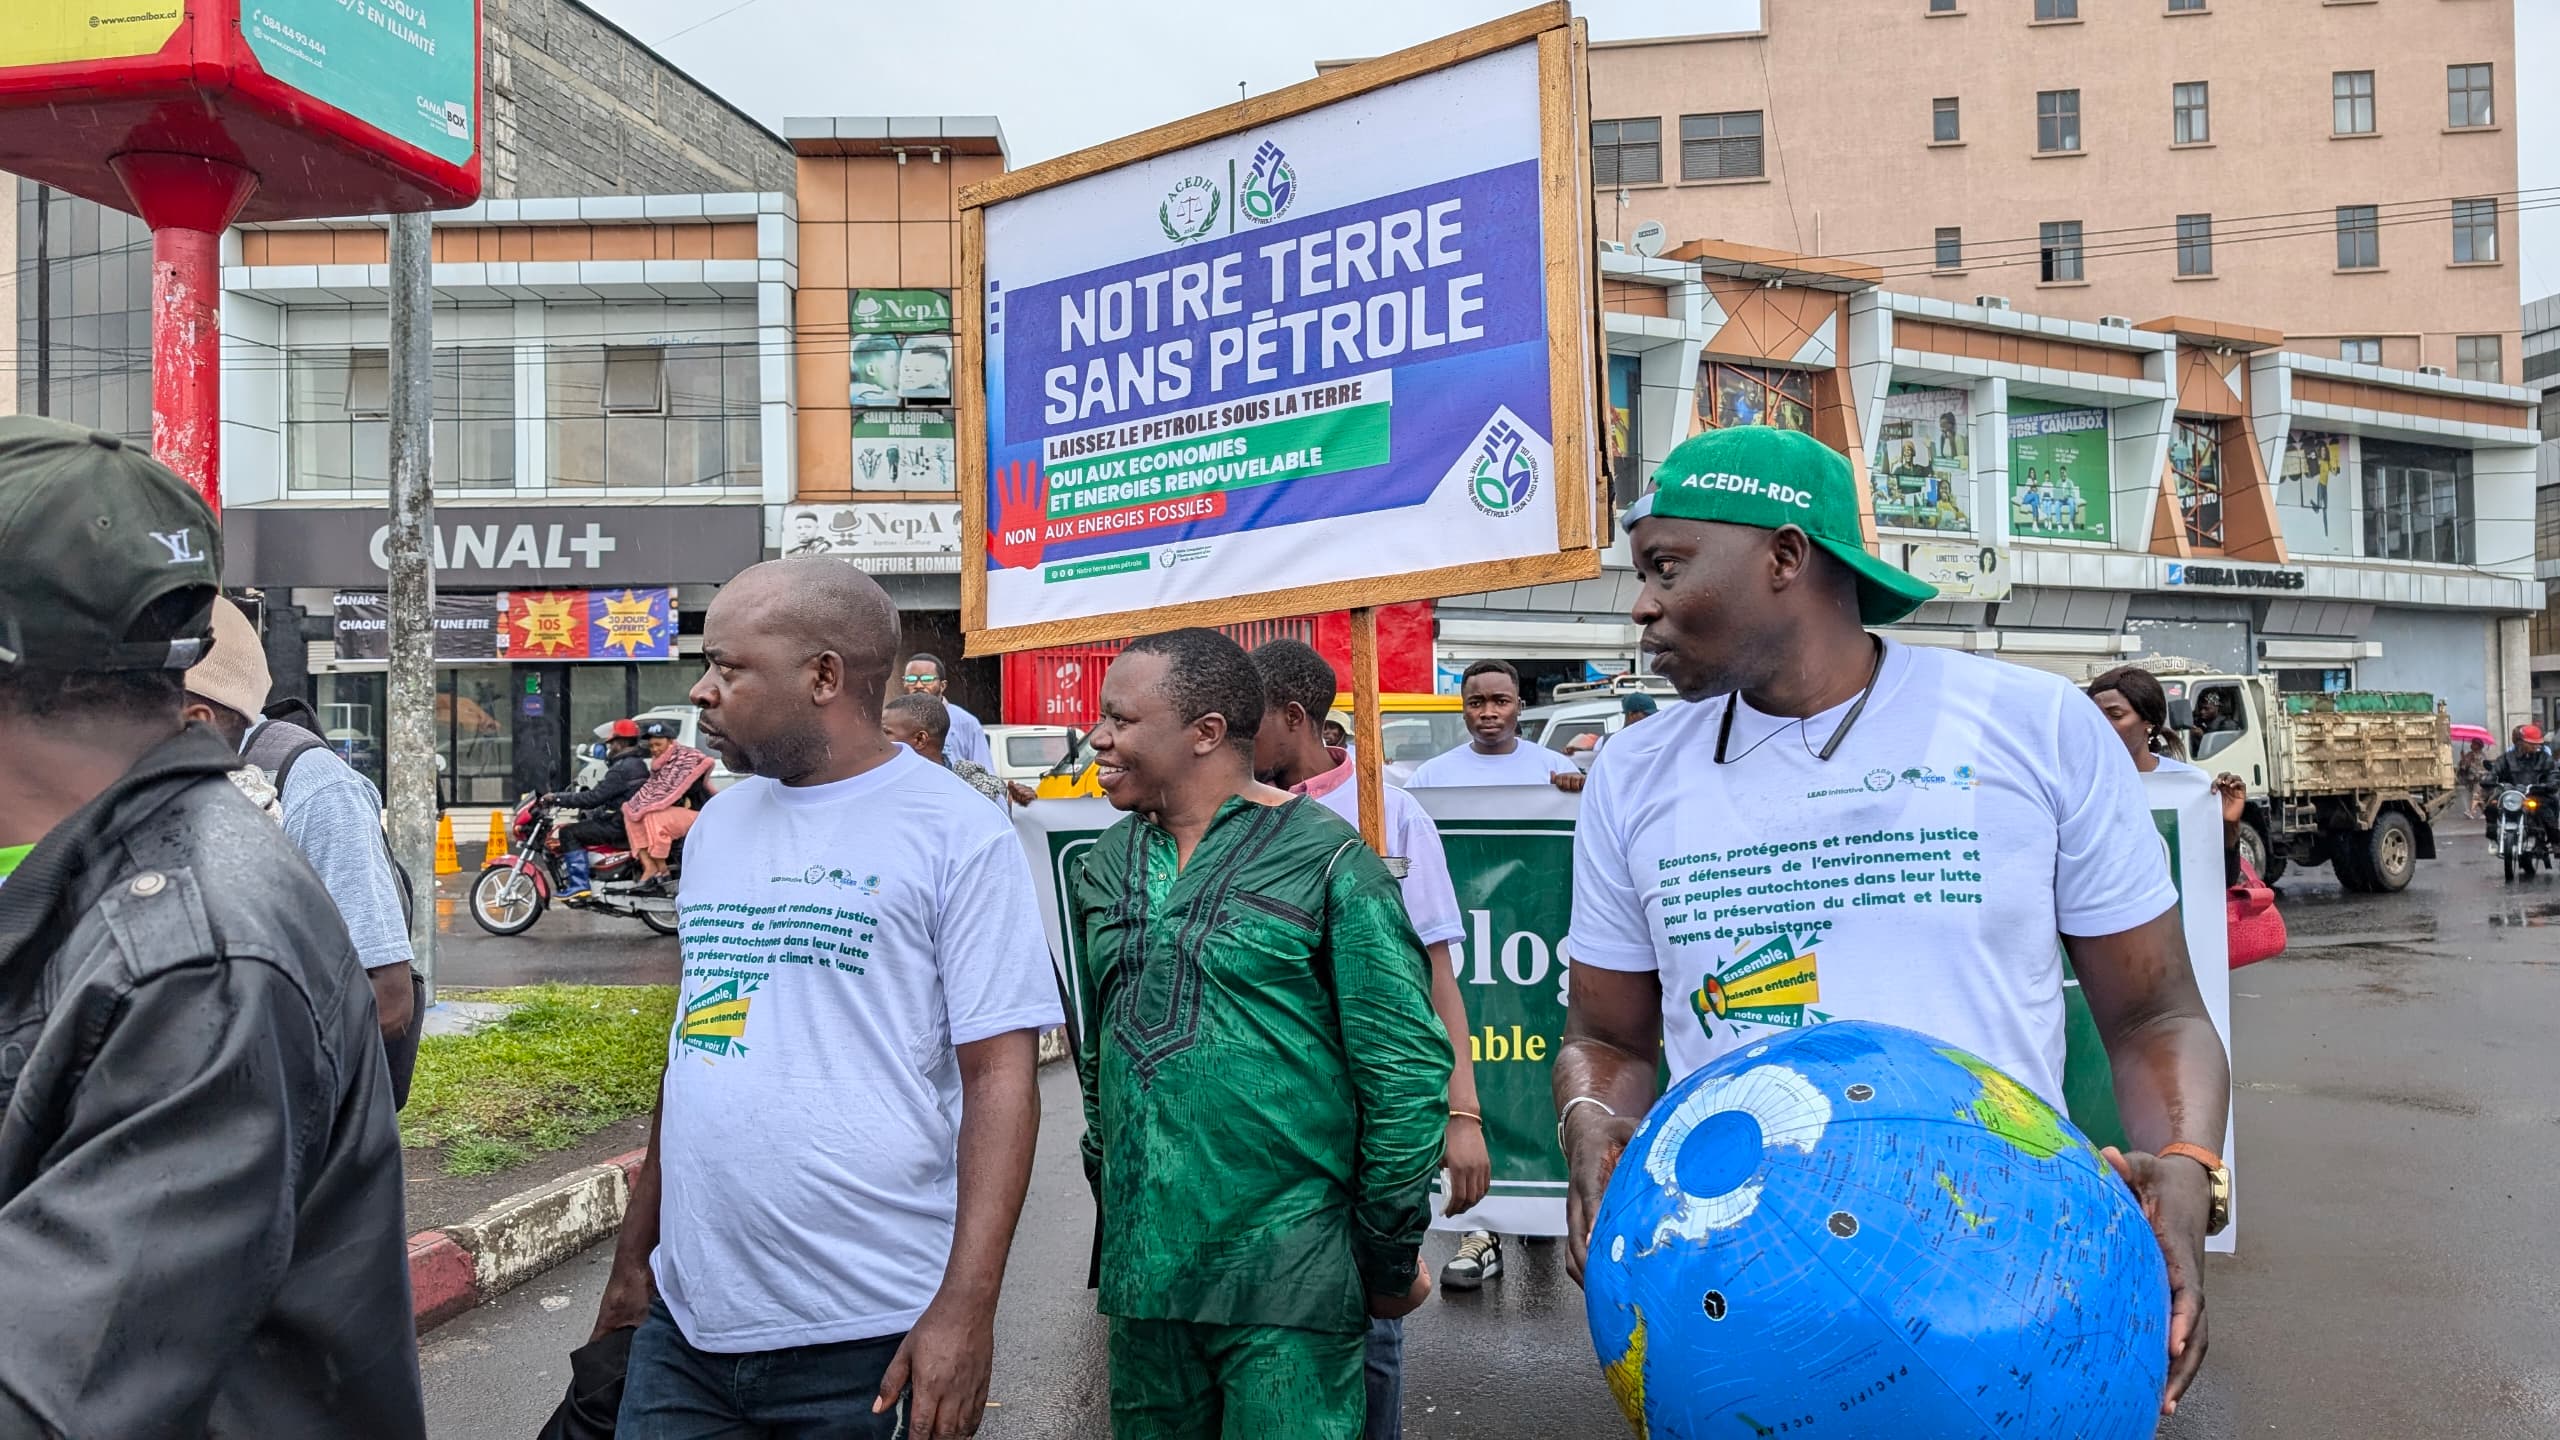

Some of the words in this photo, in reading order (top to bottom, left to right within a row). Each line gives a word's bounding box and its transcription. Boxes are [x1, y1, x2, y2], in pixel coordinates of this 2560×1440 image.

[101, 10, 177, 24] www.canalbox.cd
[263, 14, 281, 32] 084
[282, 25, 294, 39] 44
[309, 39, 326, 56] 444
[367, 6, 385, 27] EN
[388, 17, 436, 57] ILLIMITÉ
[1168, 175, 1213, 202] ACEDH
[1061, 253, 1242, 352] NOTRE
[1260, 198, 1462, 296] TERRE
[884, 298, 949, 322] NepA
[1044, 339, 1191, 424] SANS
[1211, 273, 1484, 392] PÉTROLE
[864, 412, 891, 424] SALON
[892, 412, 904, 424] DE
[905, 412, 945, 424] COIFFURE
[888, 424, 921, 436] HOMME
[1049, 431, 1115, 460] LAISSEZ
[1119, 427, 1138, 446] LE
[1143, 410, 1217, 442] PETROLE
[1222, 400, 1270, 426] SOUS
[1275, 396, 1297, 416] LA
[1302, 381, 1362, 409] TERRE
[2041, 415, 2105, 433] CANALBOX
[1051, 467, 1083, 489] OUI
[1086, 460, 1126, 483] AUX
[1130, 437, 1247, 474] ECONOMIES
[1470, 455, 1485, 474] NOTRE
[1051, 493, 1071, 512] ET
[1075, 477, 1161, 508] ENERGIES
[1165, 447, 1323, 492] RENOUVELABLE
[1681, 472, 1812, 508] ACEDH-RDC
[1470, 495, 1485, 512] SANS
[1514, 502, 1527, 513] OUR
[1526, 484, 1537, 504] LAND
[865, 511, 943, 540] NepA
[1005, 527, 1036, 546] NON
[1045, 522, 1073, 540] AUX
[1078, 510, 1144, 534] ENERGIES
[1149, 498, 1214, 523] FOSSILES
[853, 557, 913, 572] COIFFURE
[1076, 565, 1092, 575] Notre
[1092, 564, 1106, 574] terre
[1106, 563, 1121, 571] sans
[2184, 566, 2236, 586] SIMBA
[2236, 569, 2305, 590] VOYAGES
[333, 595, 378, 606] CANAL+
[339, 619, 386, 630] CHAQUE
[440, 618, 464, 629] UNE
[621, 615, 649, 626] JOURS
[1047, 694, 1083, 714] airte
[1807, 790, 1827, 798] LEAD
[1658, 852, 1722, 871] Ecoutons,
[1726, 840, 1817, 862] protégeons
[1823, 835, 1839, 848] et
[1845, 830, 1914, 845] rendons
[1920, 827, 1978, 844] justice
[1660, 875, 1681, 888] aux
[1688, 864, 1772, 883] défenseurs
[1782, 860, 1802, 872] de
[1812, 849, 1951, 869] l'environnement
[1963, 849, 1981, 861] et
[1661, 895, 1681, 907] aux
[1684, 887, 1742, 905] peuples
[1747, 876, 1849, 896] autochtones
[1854, 873, 1896, 886] dans
[1901, 869, 1935, 882] leur
[1941, 868, 1982, 882] lutte
[717, 904, 776, 916] protégeons
[777, 903, 787, 913] et
[789, 903, 833, 915] rendons
[835, 907, 878, 926] justice
[1664, 913, 1688, 928] pour
[1694, 909, 1707, 922] la
[1714, 900, 1816, 922] préservation
[1823, 896, 1844, 909] du
[1852, 892, 1906, 907] climat
[1914, 891, 1932, 903] et
[1940, 889, 1983, 904] leurs
[689, 917, 745, 929] défenseurs
[752, 921, 764, 931] de
[860, 932, 874, 943] et
[1668, 930, 1711, 946] moyens
[1714, 926, 1733, 939] de
[1737, 919, 1833, 938] subsistance
[686, 932, 719, 946] peuples
[722, 936, 781, 947] autochtones
[783, 935, 808, 946] dans
[812, 936, 836, 951] leur
[839, 942, 869, 960] lutte
[694, 966, 705, 977] de
[707, 966, 770, 980] subsistance
[697, 949, 764, 963] préservation
[779, 952, 814, 964] climat
[819, 958, 831, 968] et
[836, 959, 865, 976] leurs
[1723, 948, 1788, 982] Ensemble,
[1765, 971, 1816, 992] entendre
[710, 1010, 747, 1023] entendre
[1735, 1011, 1763, 1020] notre
[1839, 1364, 1908, 1412] PACIFIC
